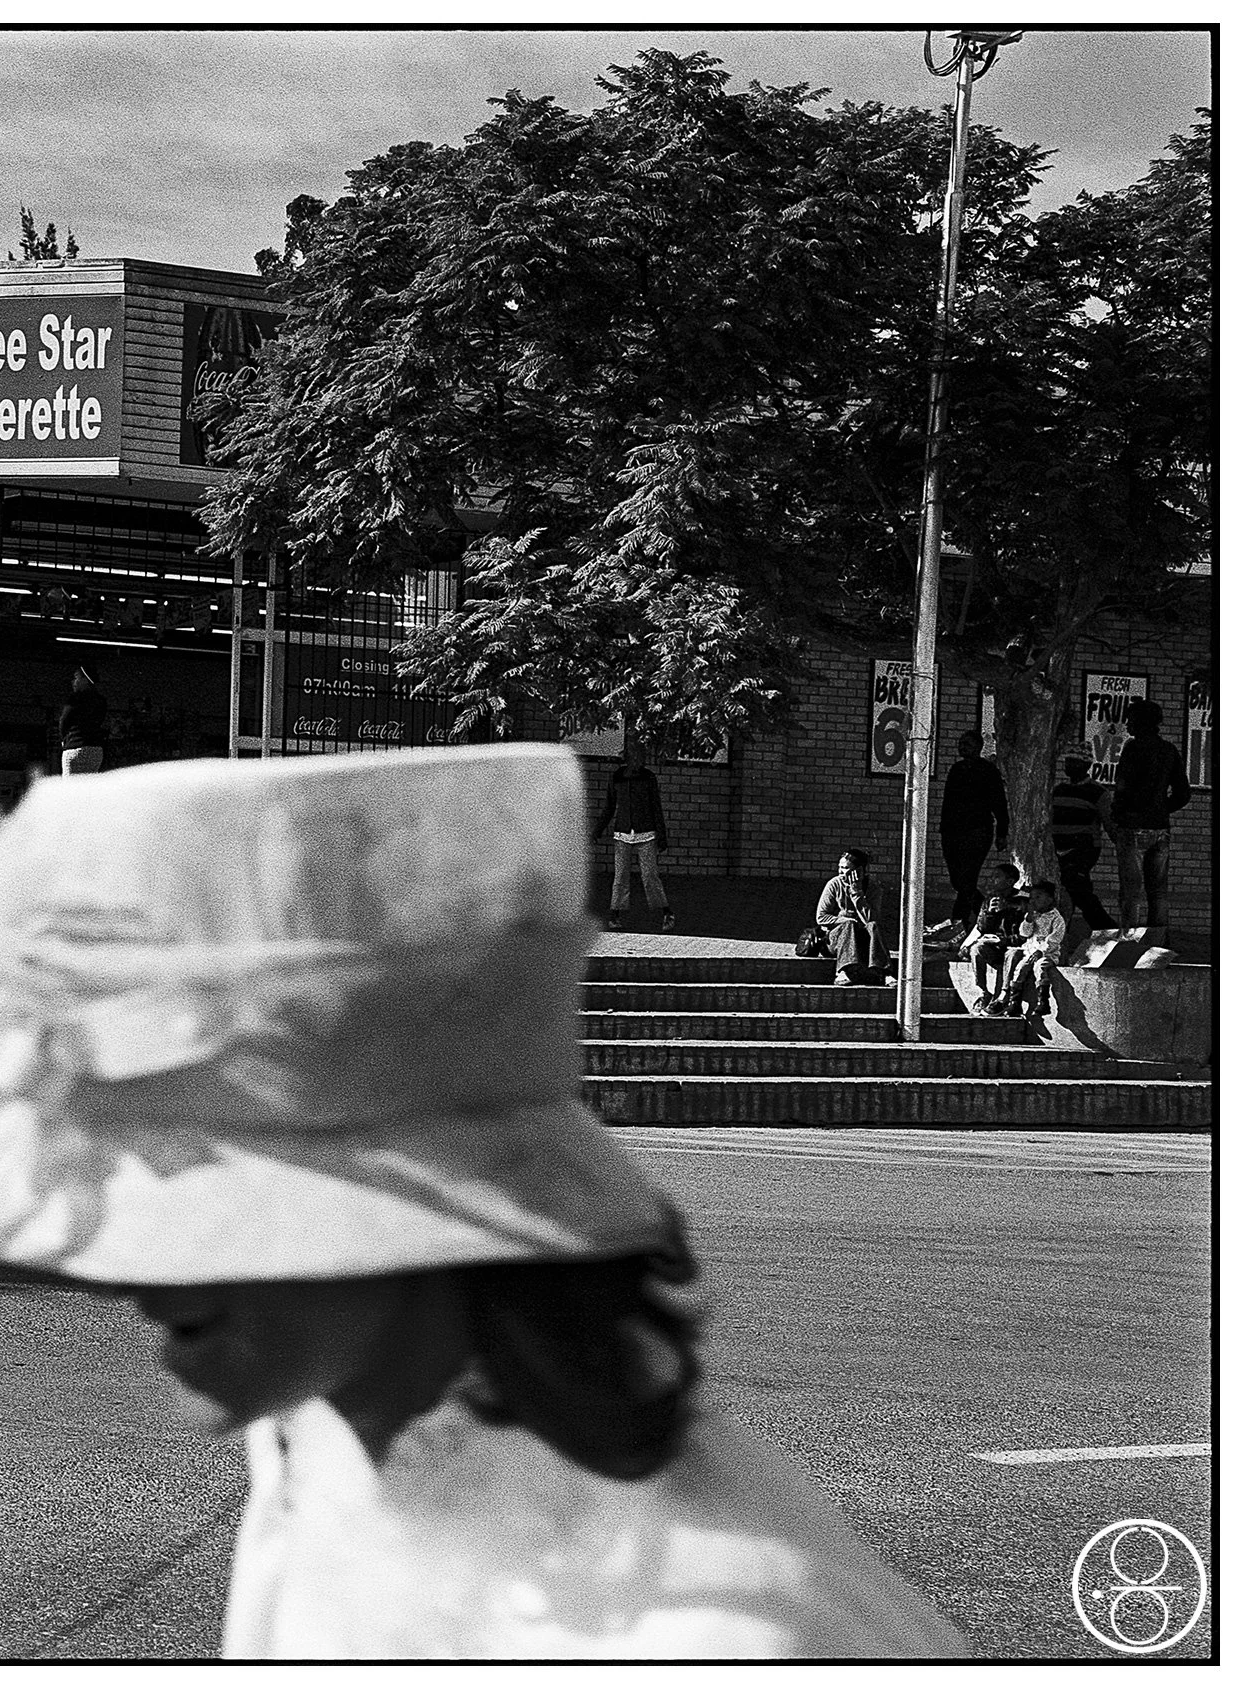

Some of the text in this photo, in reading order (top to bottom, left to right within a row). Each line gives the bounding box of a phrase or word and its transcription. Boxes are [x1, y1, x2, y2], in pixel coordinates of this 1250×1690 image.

[39, 313, 113, 372] Star
[341, 658, 390, 675] Closing
[1101, 677, 1131, 692] FRESH
[873, 707, 907, 768] 6
